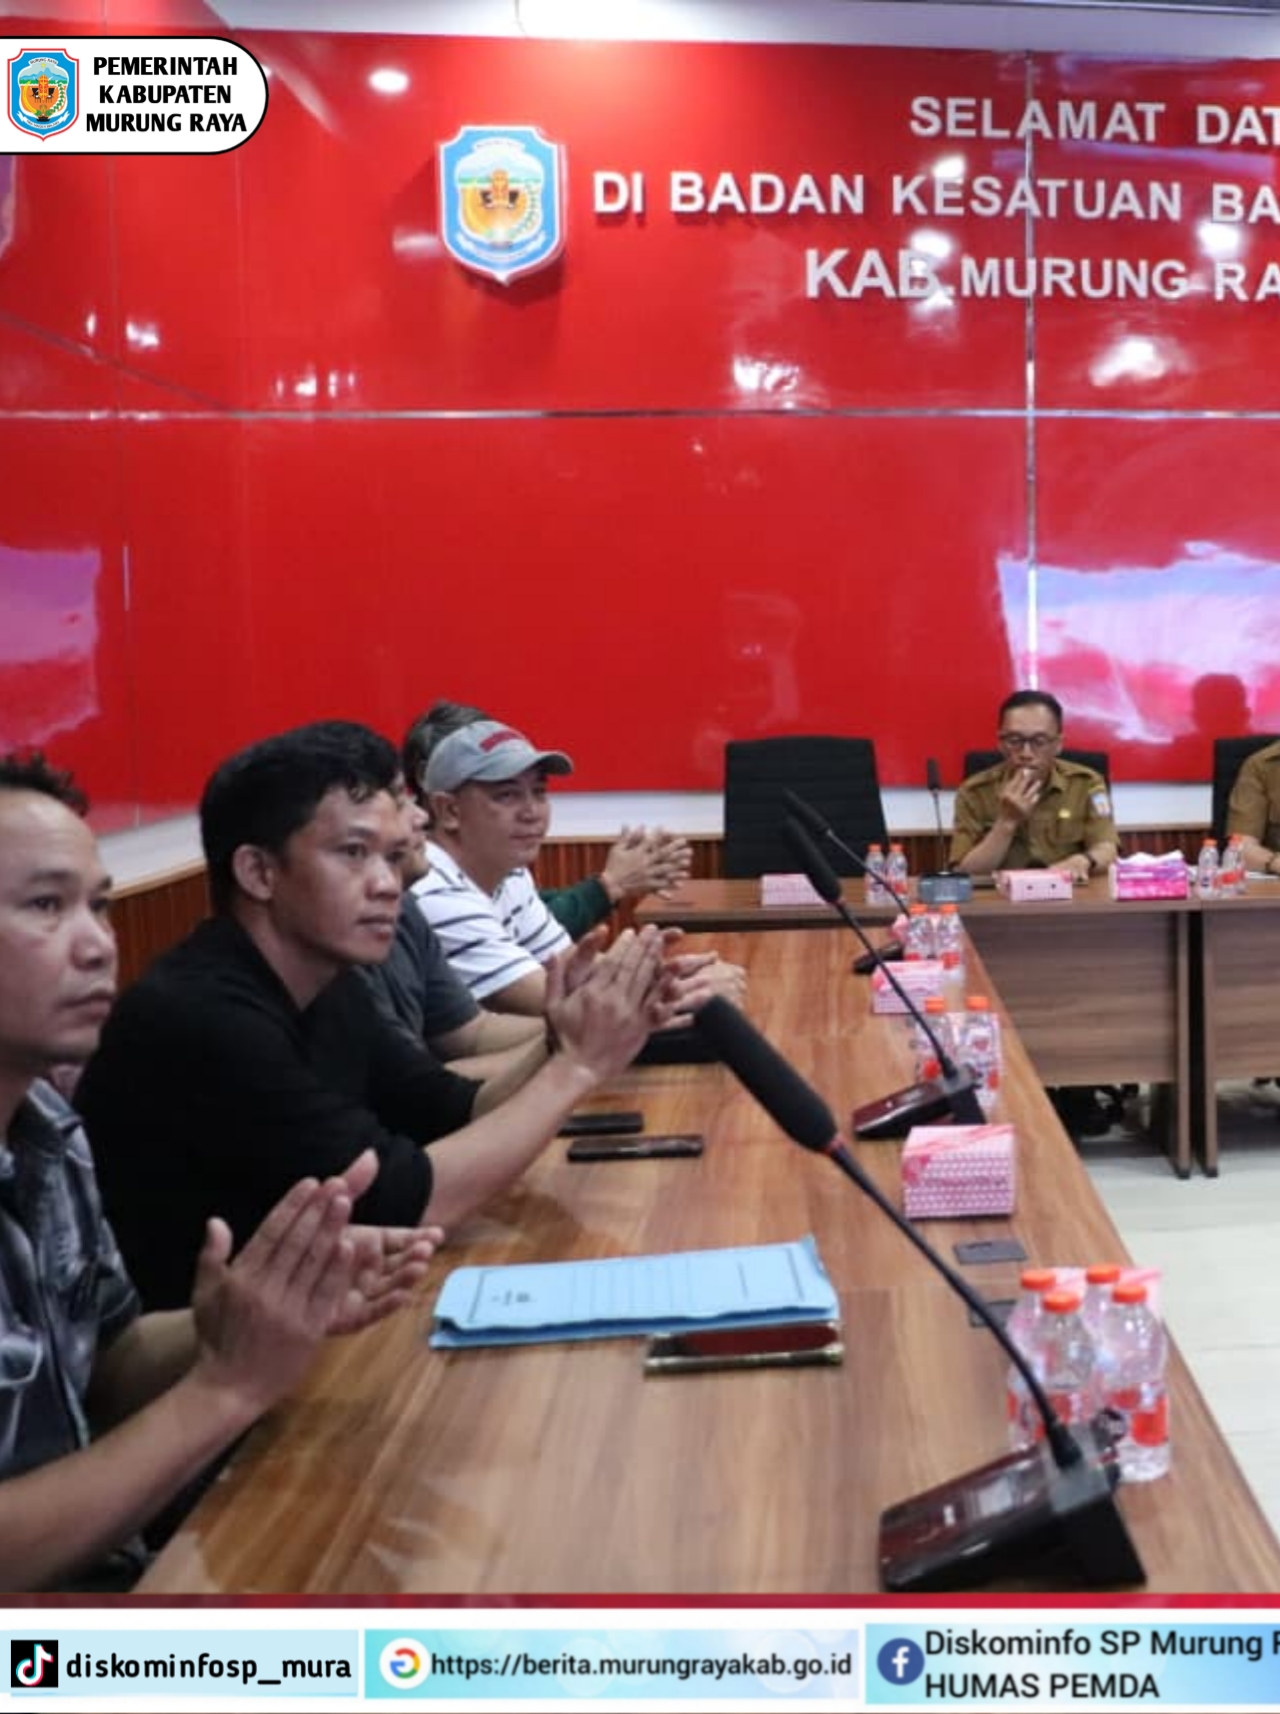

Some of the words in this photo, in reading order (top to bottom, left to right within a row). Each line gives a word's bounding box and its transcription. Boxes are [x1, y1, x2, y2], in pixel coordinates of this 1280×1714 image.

[910, 96, 1165, 143] SELAMAT
[592, 170, 643, 213] DI
[669, 171, 865, 215] BADAN
[892, 174, 1182, 221] KESATUAN
